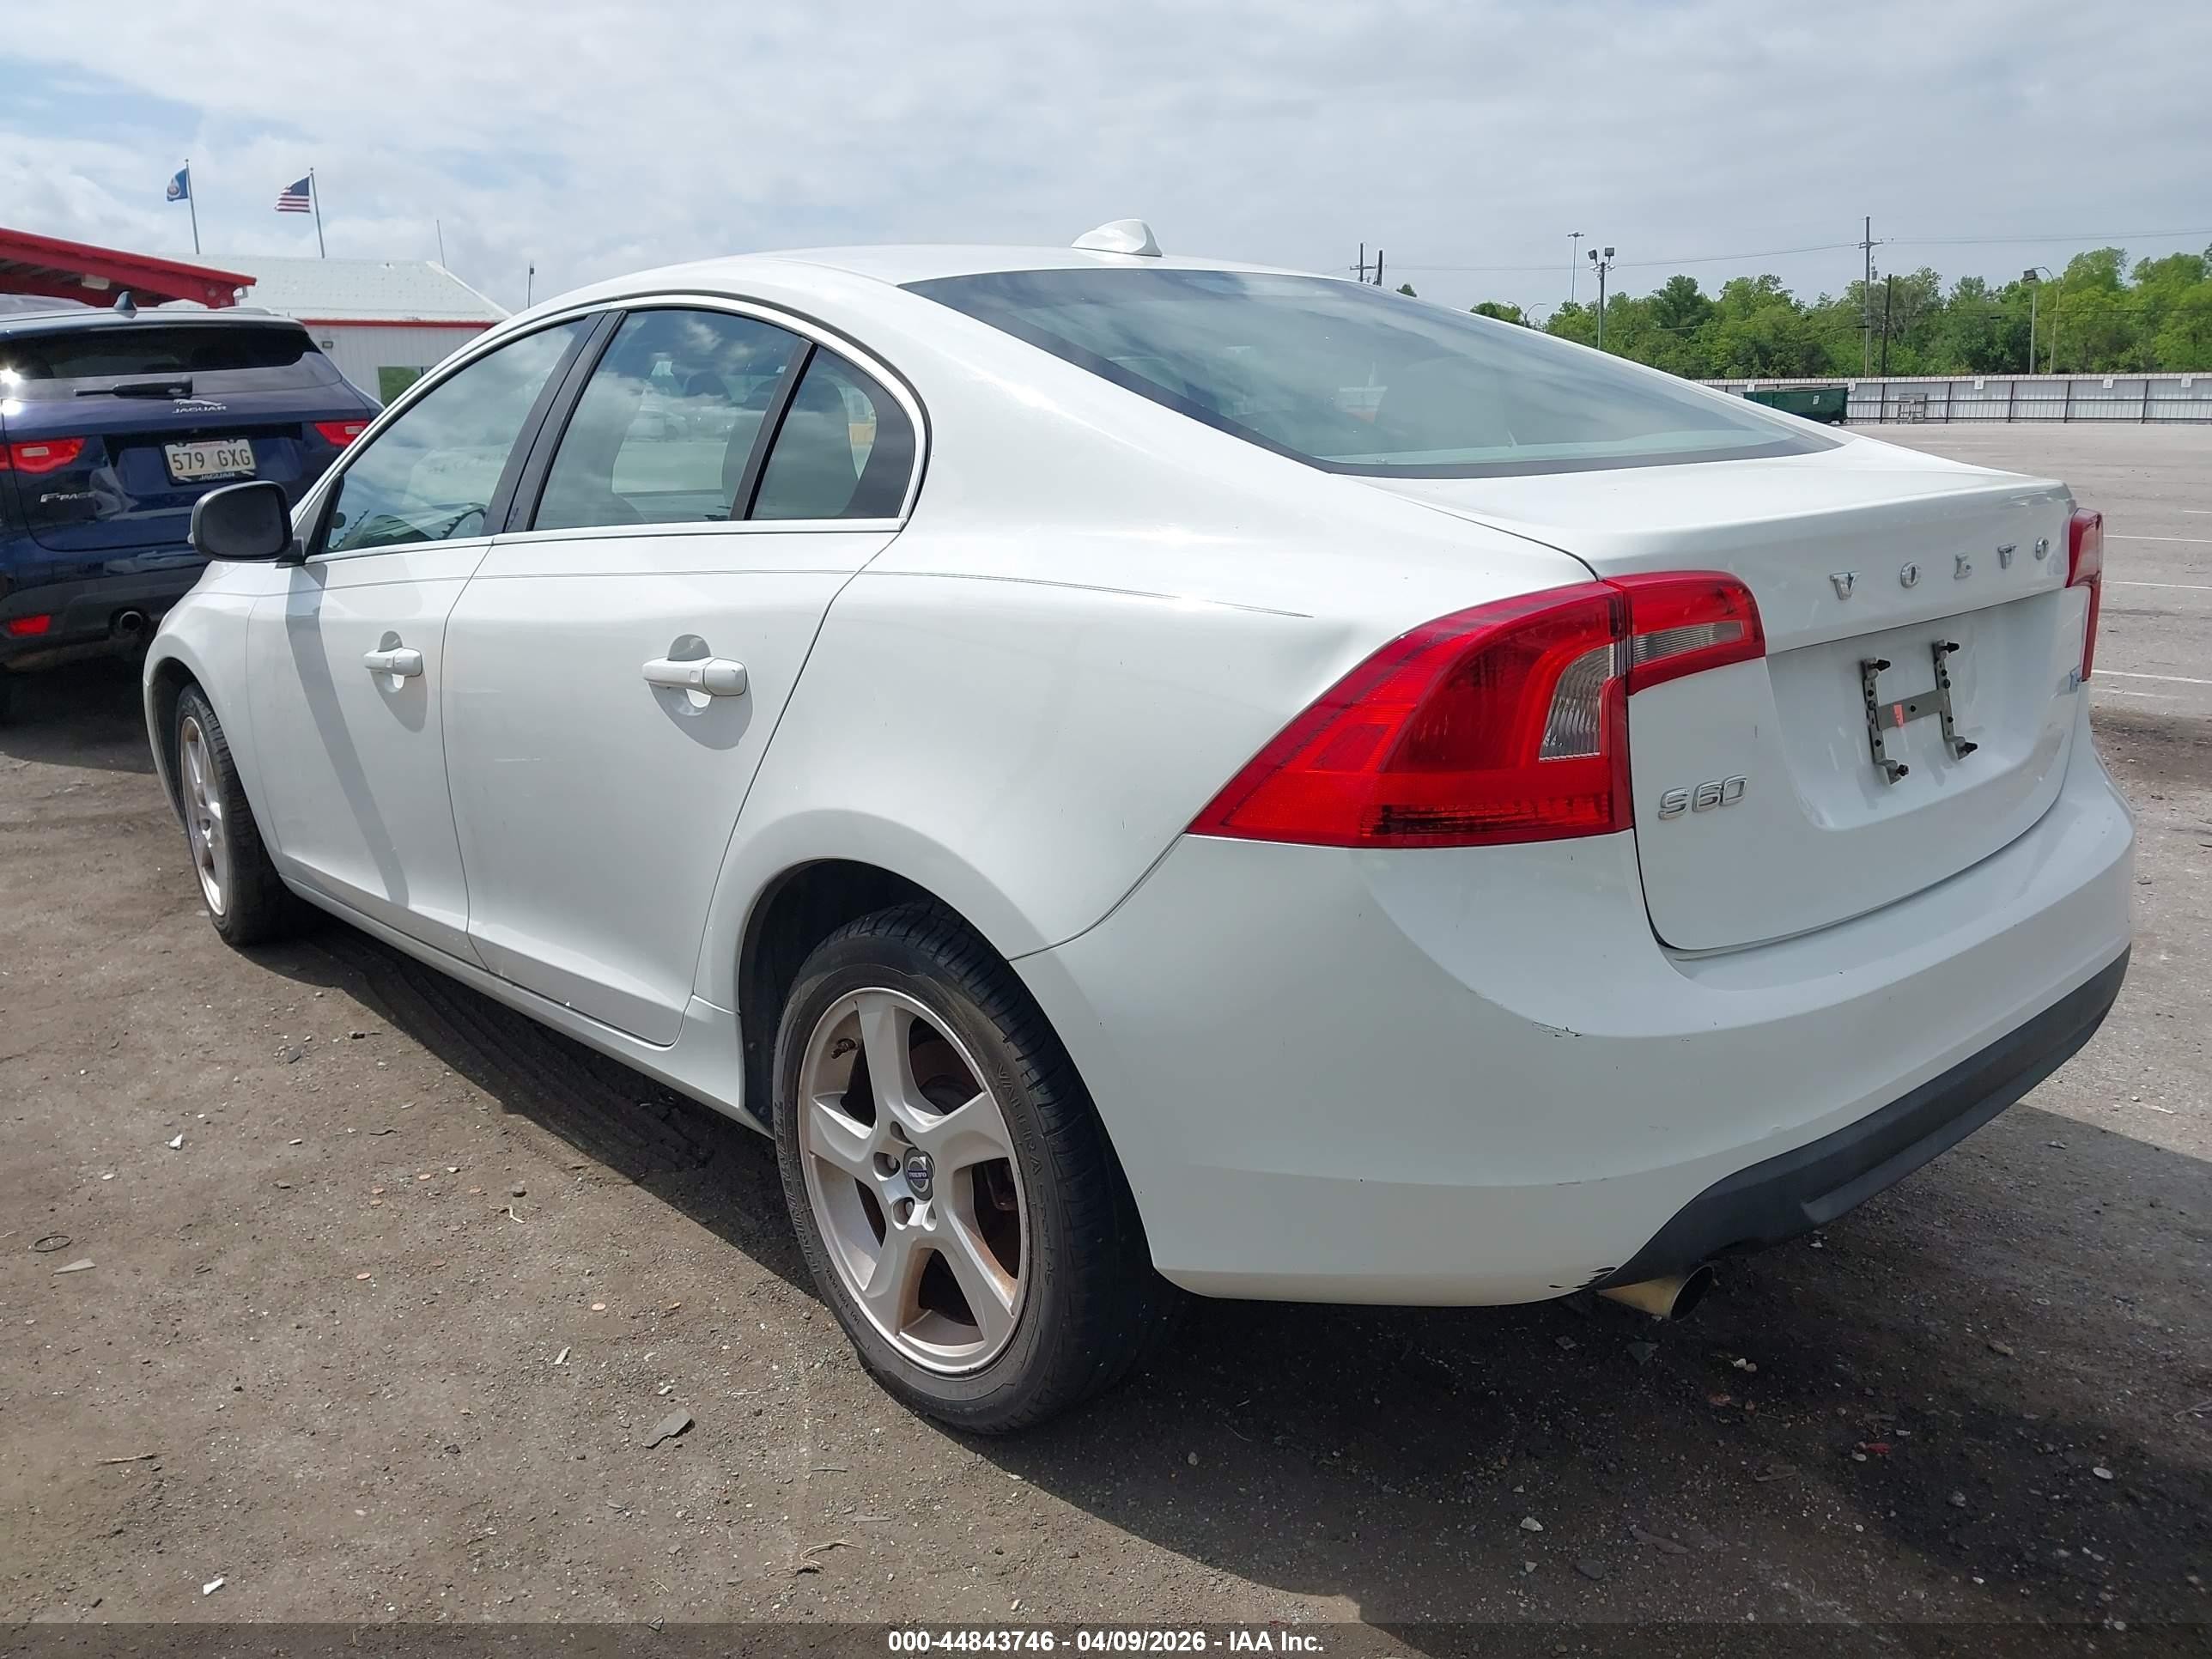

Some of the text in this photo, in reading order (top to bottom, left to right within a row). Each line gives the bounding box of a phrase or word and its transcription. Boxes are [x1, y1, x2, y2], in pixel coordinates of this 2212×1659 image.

[172, 448, 252, 471] 579 GXG
[1829, 537, 2049, 601] VOLVO
[1657, 774, 1747, 820] S60
